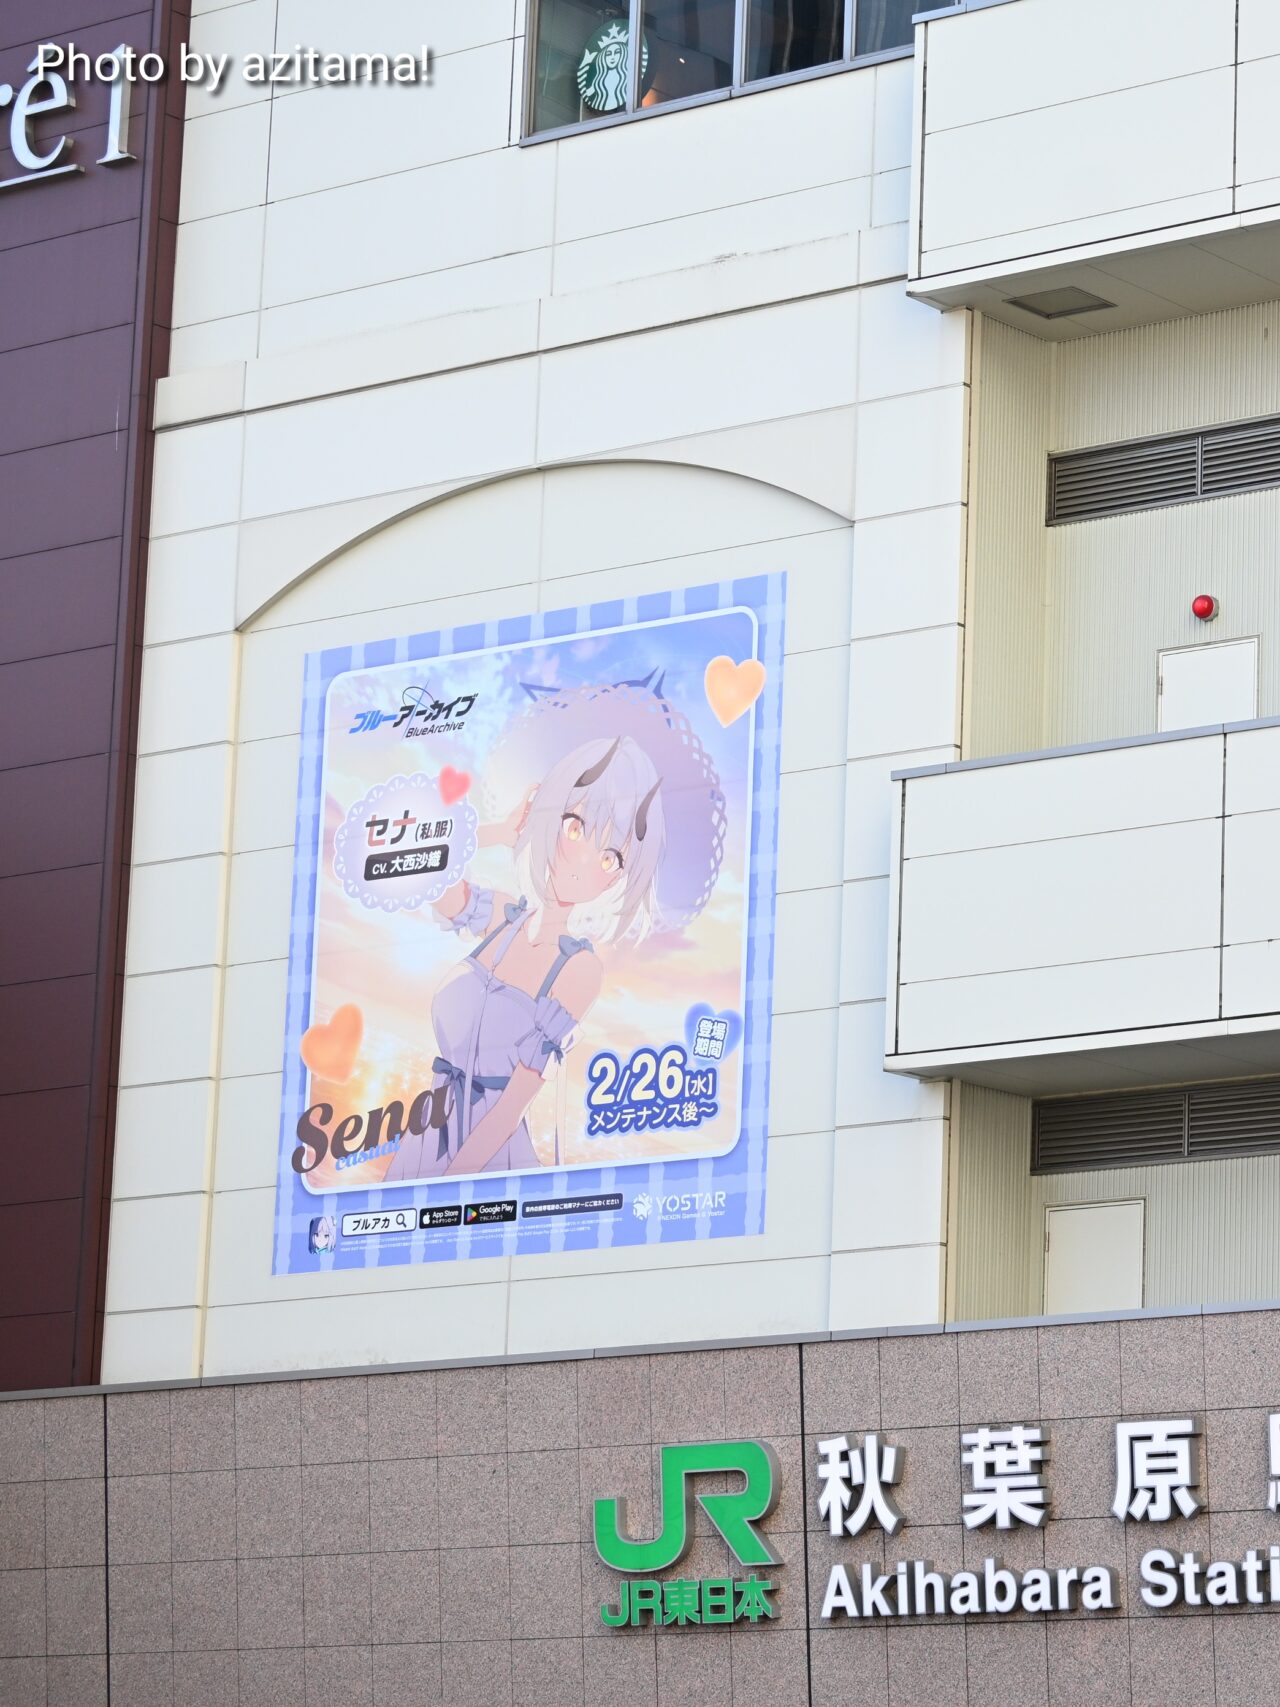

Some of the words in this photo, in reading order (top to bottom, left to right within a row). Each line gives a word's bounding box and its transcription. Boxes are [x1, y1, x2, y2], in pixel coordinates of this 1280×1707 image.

[0, 42, 76, 170] é
[349, 693, 479, 734] ブルーアーカイブ
[405, 721, 465, 738] BlueArchive
[372, 862, 387, 875] CV.
[697, 1018, 727, 1041] 登場
[693, 1037, 724, 1059] 期間
[291, 1084, 456, 1173] Sena
[335, 1132, 401, 1171] casual
[479, 1204, 501, 1214] Google
[501, 1203, 514, 1213] Play
[656, 1191, 726, 1213] YOSTAR
[352, 1217, 390, 1232] ブルアカ
[432, 1211, 443, 1219] App
[444, 1209, 459, 1217] Store
[593, 1439, 784, 1575] JR
[820, 1558, 1117, 1620] Akihabara
[599, 1573, 778, 1629] JR東日本
